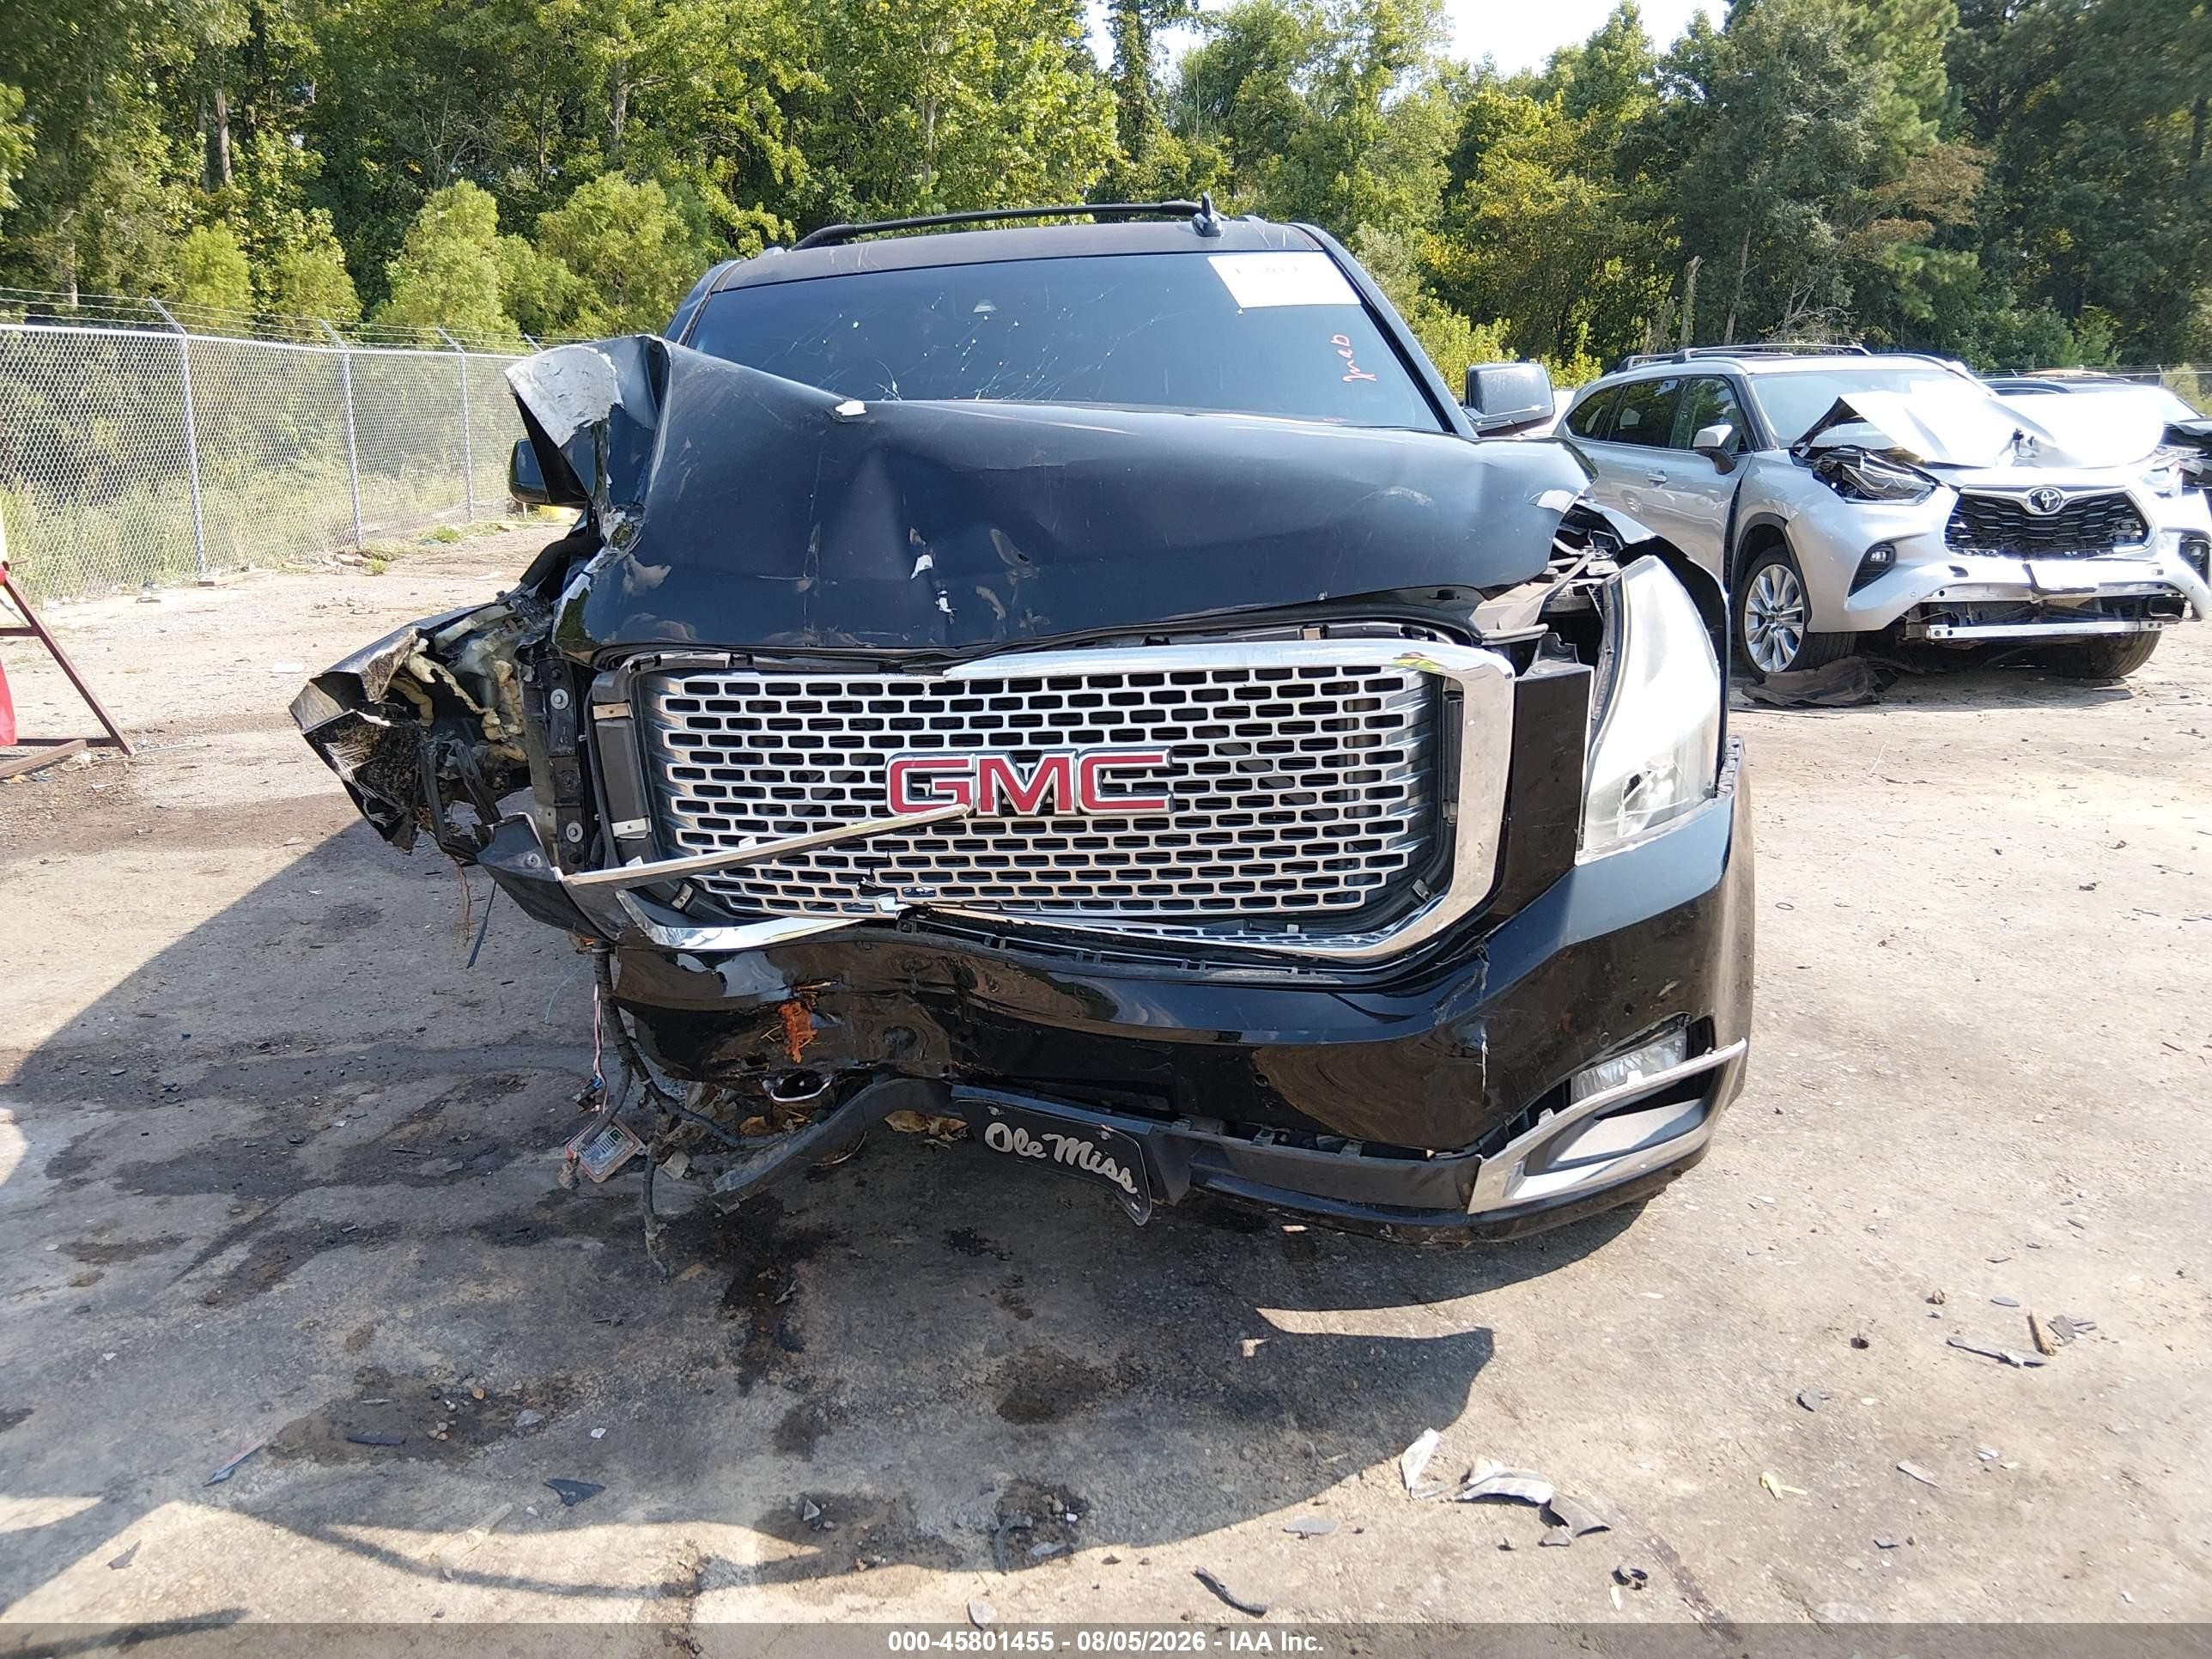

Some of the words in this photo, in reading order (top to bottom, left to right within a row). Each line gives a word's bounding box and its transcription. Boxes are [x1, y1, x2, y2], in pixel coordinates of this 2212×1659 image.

[885, 747, 1174, 817] GMC
[984, 1121, 1047, 1159] Ole
[1042, 1133, 1139, 1194] Miss
